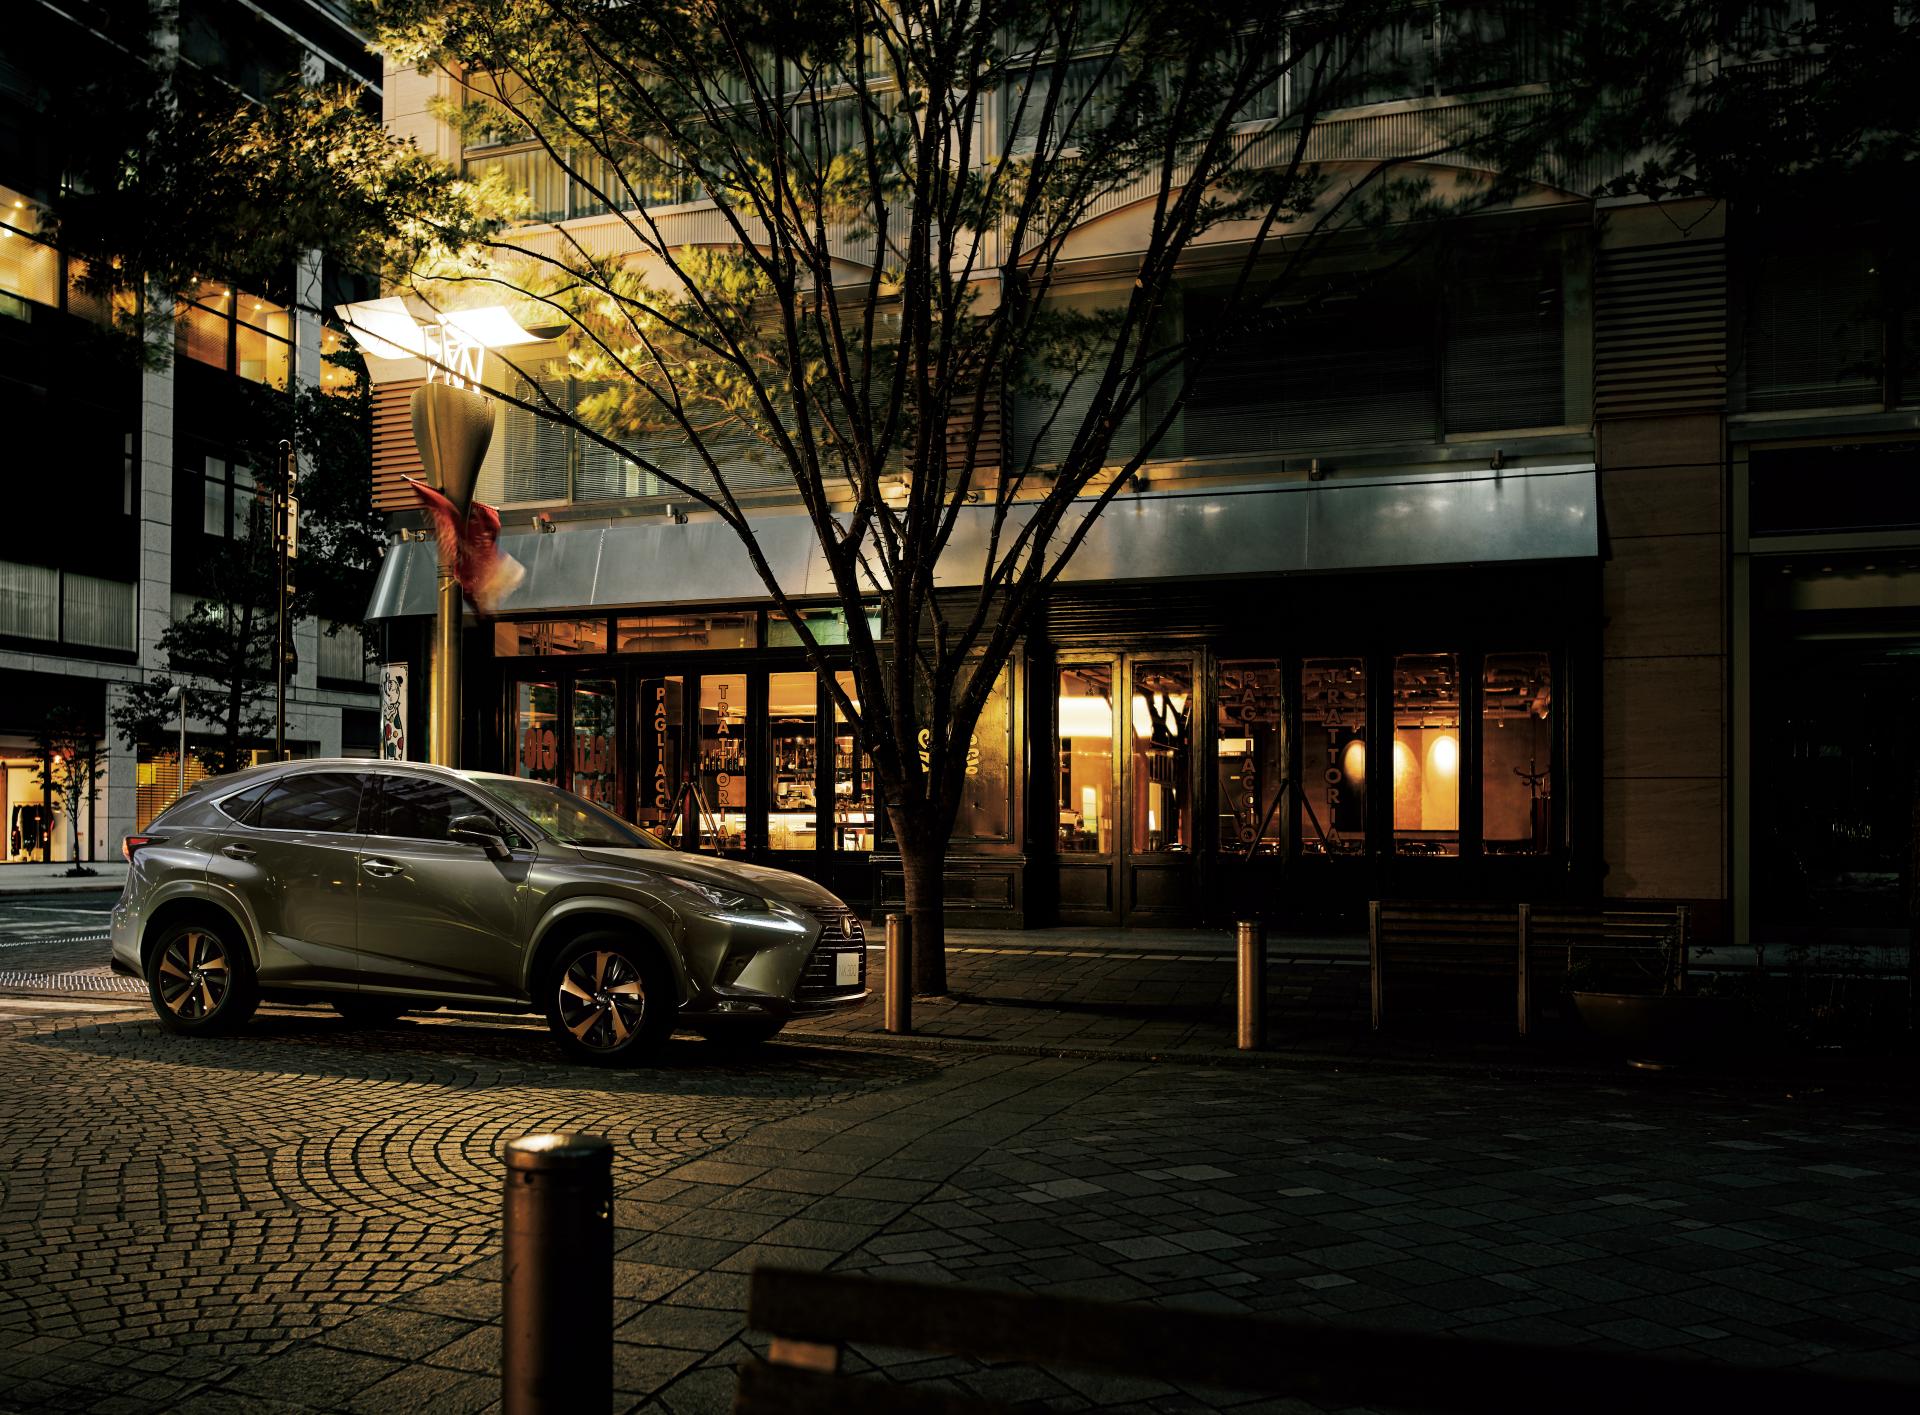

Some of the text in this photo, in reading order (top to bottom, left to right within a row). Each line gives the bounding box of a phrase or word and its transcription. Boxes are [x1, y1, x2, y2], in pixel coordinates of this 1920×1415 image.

[654, 687, 667, 838] PAGLIACCIO
[716, 685, 730, 839] TRATTORIA
[1240, 671, 1257, 843] PAGLIACCIO
[1324, 668, 1343, 847] TRATTORIA
